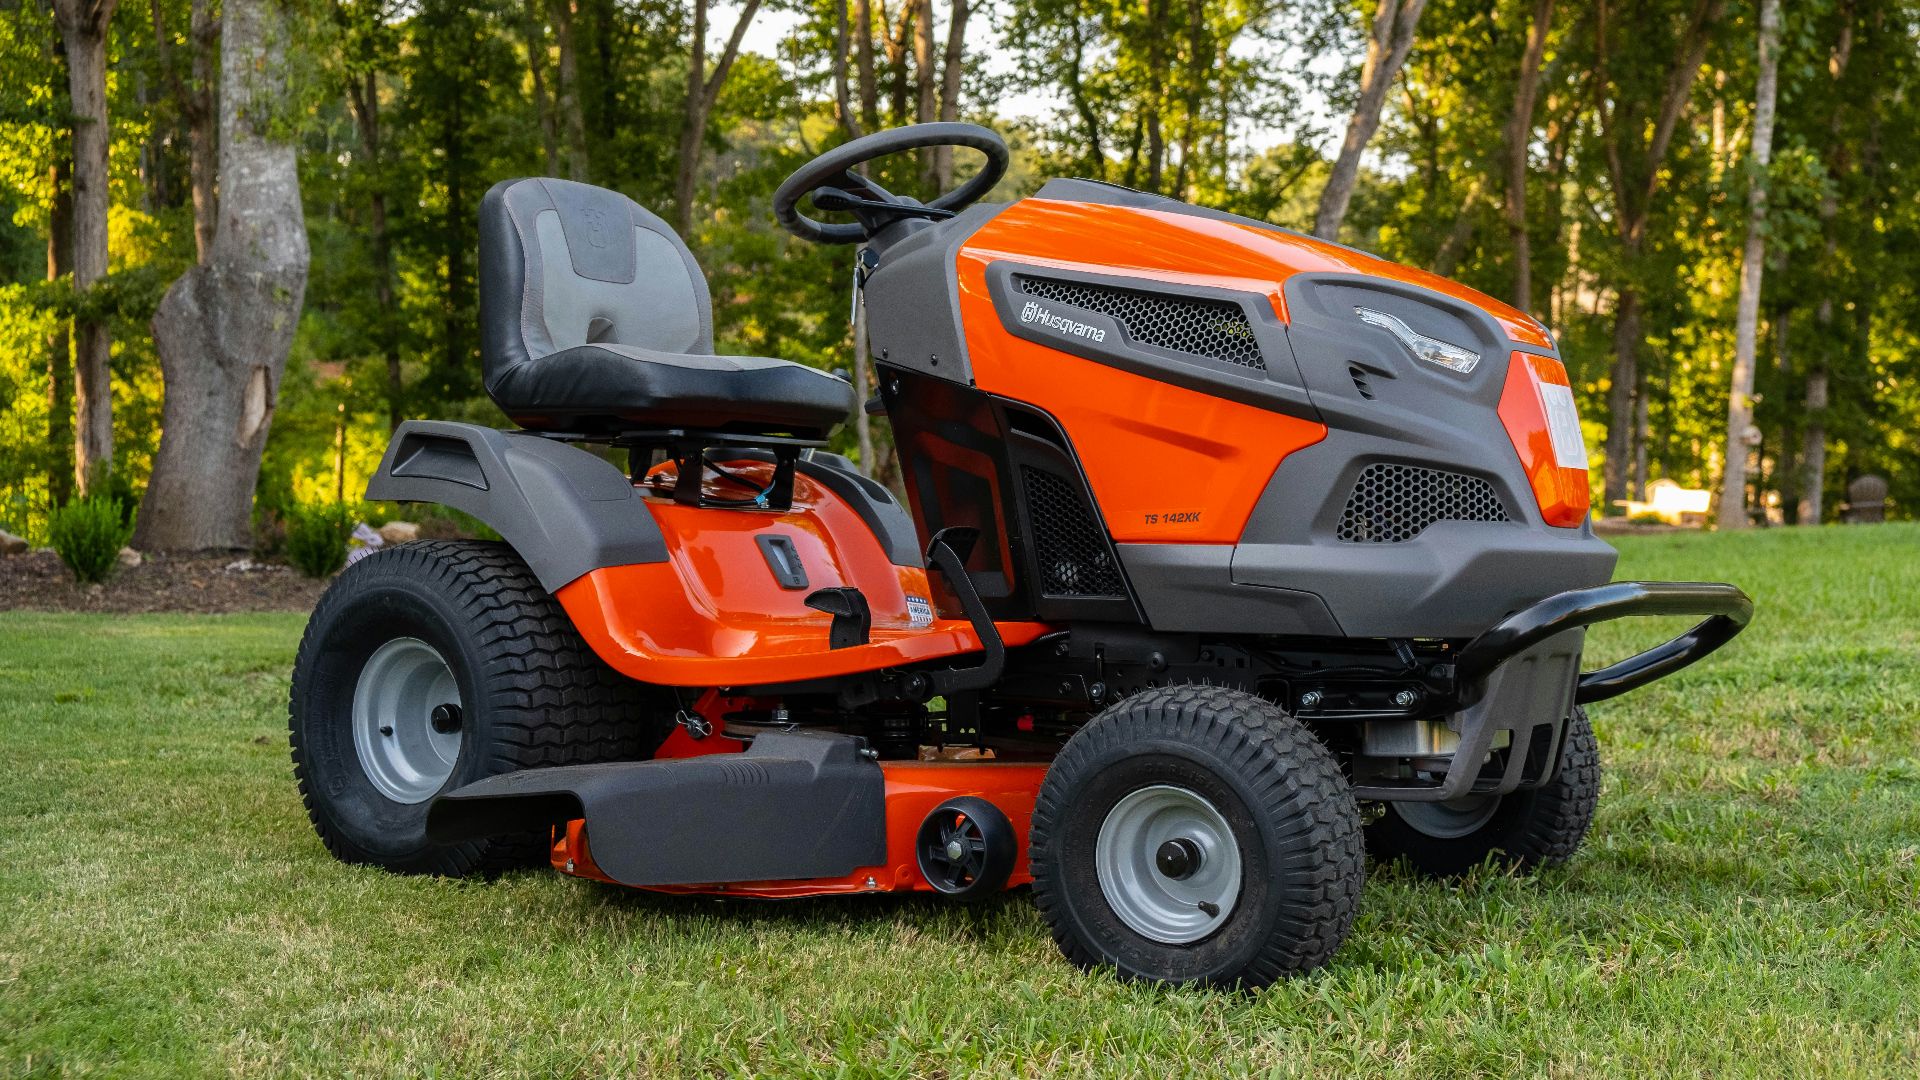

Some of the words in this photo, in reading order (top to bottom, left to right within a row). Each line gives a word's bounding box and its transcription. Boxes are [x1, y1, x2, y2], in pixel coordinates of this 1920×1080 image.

[1035, 307, 1106, 343] Husqvarna
[1145, 514, 1159, 525] TS
[1163, 512, 1201, 523] 142XK
